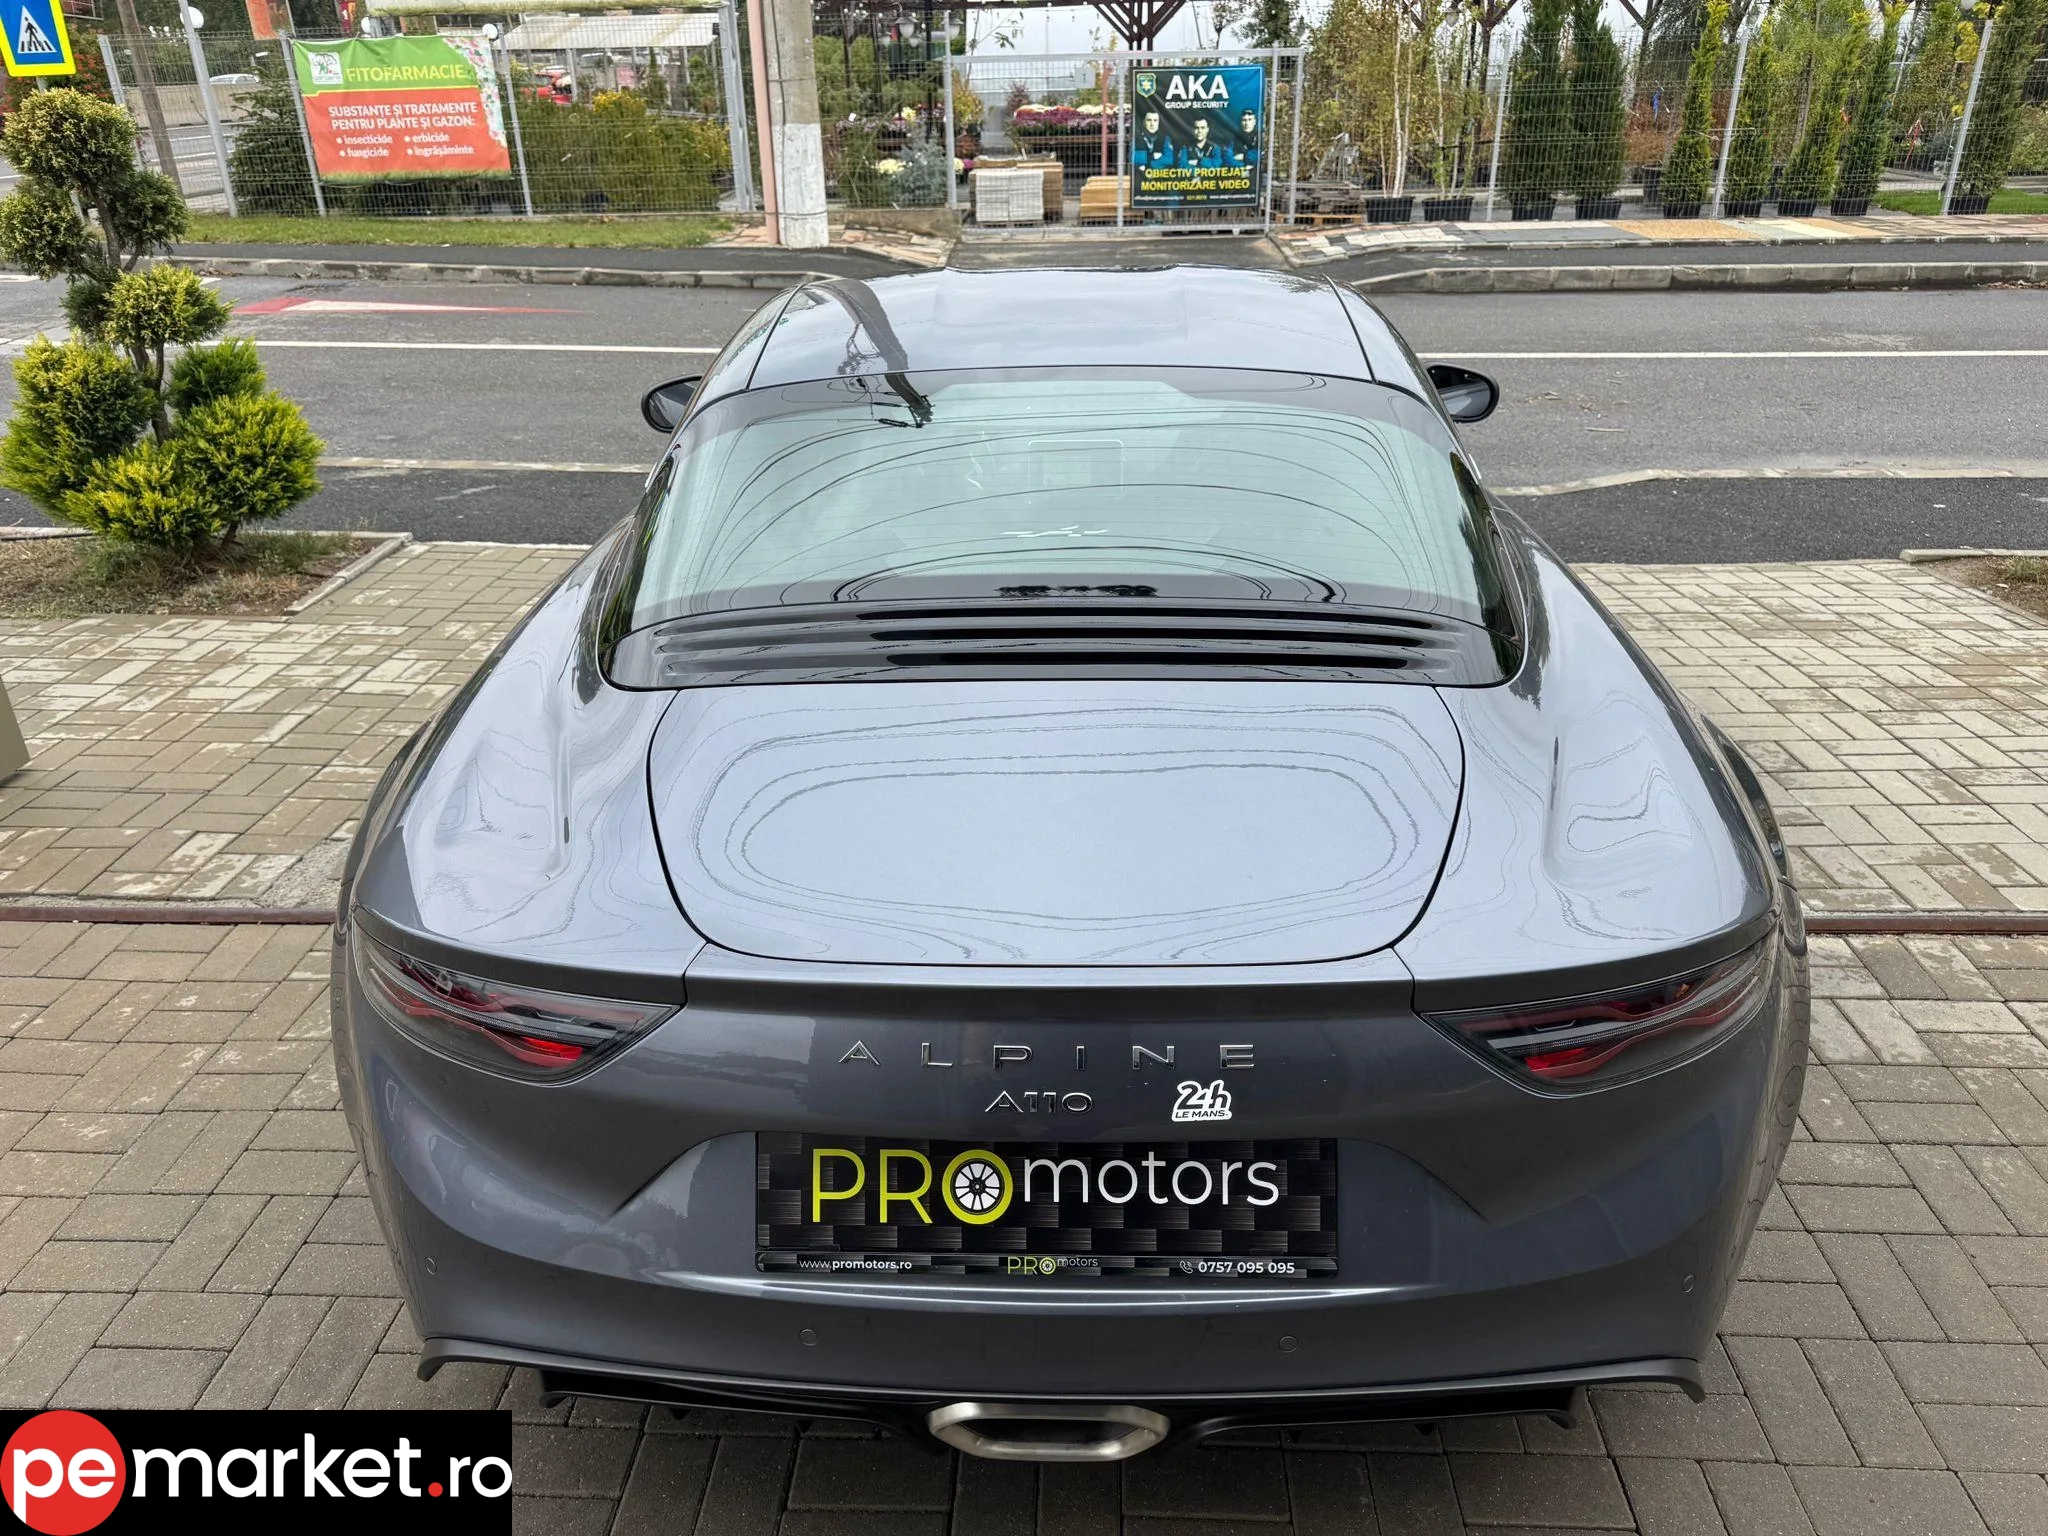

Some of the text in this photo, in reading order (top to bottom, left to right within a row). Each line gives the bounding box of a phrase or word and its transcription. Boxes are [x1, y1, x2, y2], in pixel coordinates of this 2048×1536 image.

[346, 64, 467, 82] FITOFARMACIE
[1165, 75, 1229, 99] AKA
[404, 102, 478, 116] TRATAMENTE
[1165, 101, 1229, 109] GROUP SECURITY
[331, 118, 375, 130] PENTRU
[377, 117, 418, 129] PLANTE
[434, 115, 476, 127] GAZON:
[343, 135, 393, 144] insecticide
[412, 133, 450, 143] erbicide
[347, 148, 389, 159] fungicide
[1144, 167, 1248, 178] OBIECTIV PROTEJAT
[1140, 179, 1250, 190] MONITORIZARE VIDEO
[838, 1040, 1256, 1070] ALPINE
[984, 1090, 1094, 1114] A110
[1177, 1082, 1229, 1110] 24h
[799, 1258, 913, 1271] www.promotors.ro
[1198, 1261, 1296, 1274] 0757 095 095
